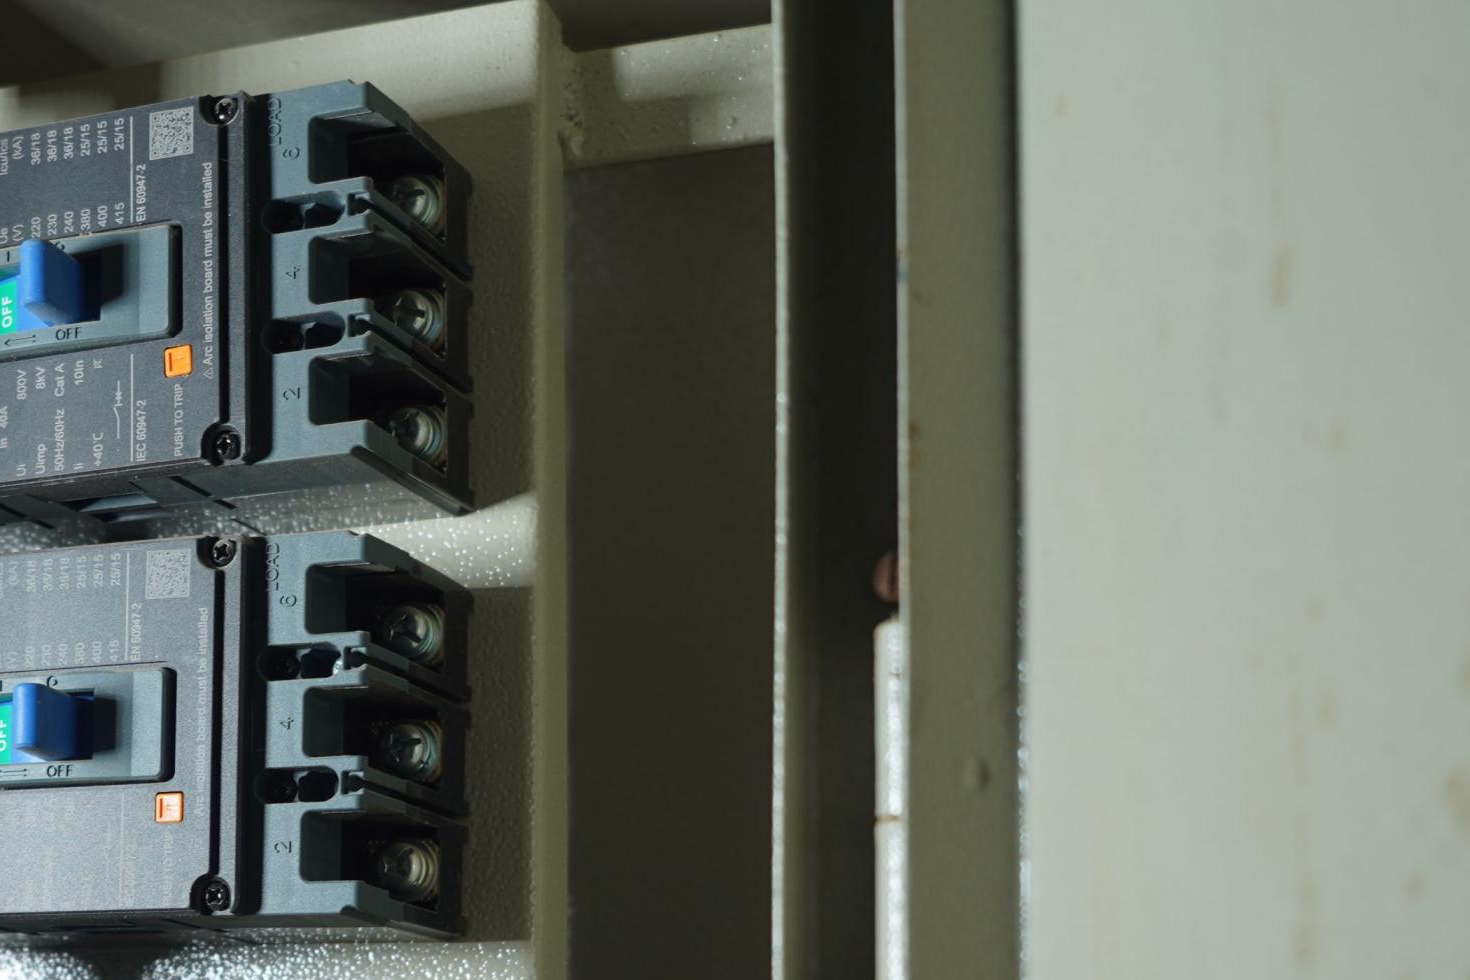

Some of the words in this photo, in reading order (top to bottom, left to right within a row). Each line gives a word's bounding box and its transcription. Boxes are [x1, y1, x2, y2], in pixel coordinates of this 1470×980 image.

[268, 97, 282, 146] LOAD
[64, 127, 74, 159] 36/18
[80, 125, 91, 157] 25/15
[97, 121, 107, 153] 25/15
[114, 118, 124, 150] 25/15
[12, 136, 24, 159] (kA)
[31, 133, 41, 165] 36/18
[47, 130, 57, 162] 36/18
[283, 148, 299, 160] 6
[136, 164, 146, 204] 60947-2
[202, 162, 213, 209] installed
[64, 211, 74, 233] 240
[81, 209, 91, 230] 380
[97, 206, 108, 227] 400
[114, 202, 125, 224] 415
[136, 207, 146, 221] EN
[202, 212, 213, 229] be
[13, 225, 25, 241] (V)
[31, 217, 42, 237] 220
[47, 214, 58, 235] 230
[203, 232, 213, 257] must
[202, 260, 213, 292] board
[283, 266, 300, 279] 4
[2, 297, 13, 328] OFF
[202, 295, 213, 343] isolation
[55, 327, 81, 340] OFF
[202, 346, 213, 365] Arc
[35, 367, 46, 389] 8kV
[55, 363, 65, 373] A
[16, 369, 27, 399] 800V
[54, 376, 65, 397] Cat
[283, 387, 300, 401] 2
[174, 384, 184, 407] TRIP
[136, 399, 146, 440] 60947-2
[174, 410, 184, 426] TO
[54, 409, 65, 471] 50Hz/60Hz
[174, 429, 184, 456] PUSH
[35, 444, 47, 473] Uimp
[136, 443, 147, 462] IEC
[16, 464, 26, 475] Ui
[111, 553, 120, 586] 25/15
[266, 543, 279, 592] LOAD
[279, 594, 295, 607] 6
[132, 603, 141, 643] 60947-2
[197, 608, 208, 655] installed
[132, 646, 140, 660] EN
[197, 659, 208, 676] be
[198, 678, 208, 704] must
[196, 708, 207, 740] board
[279, 716, 294, 731] 4
[46, 764, 74, 776] OFF
[196, 745, 206, 792] isolation
[195, 797, 205, 815] Arc
[275, 841, 291, 854] 2
